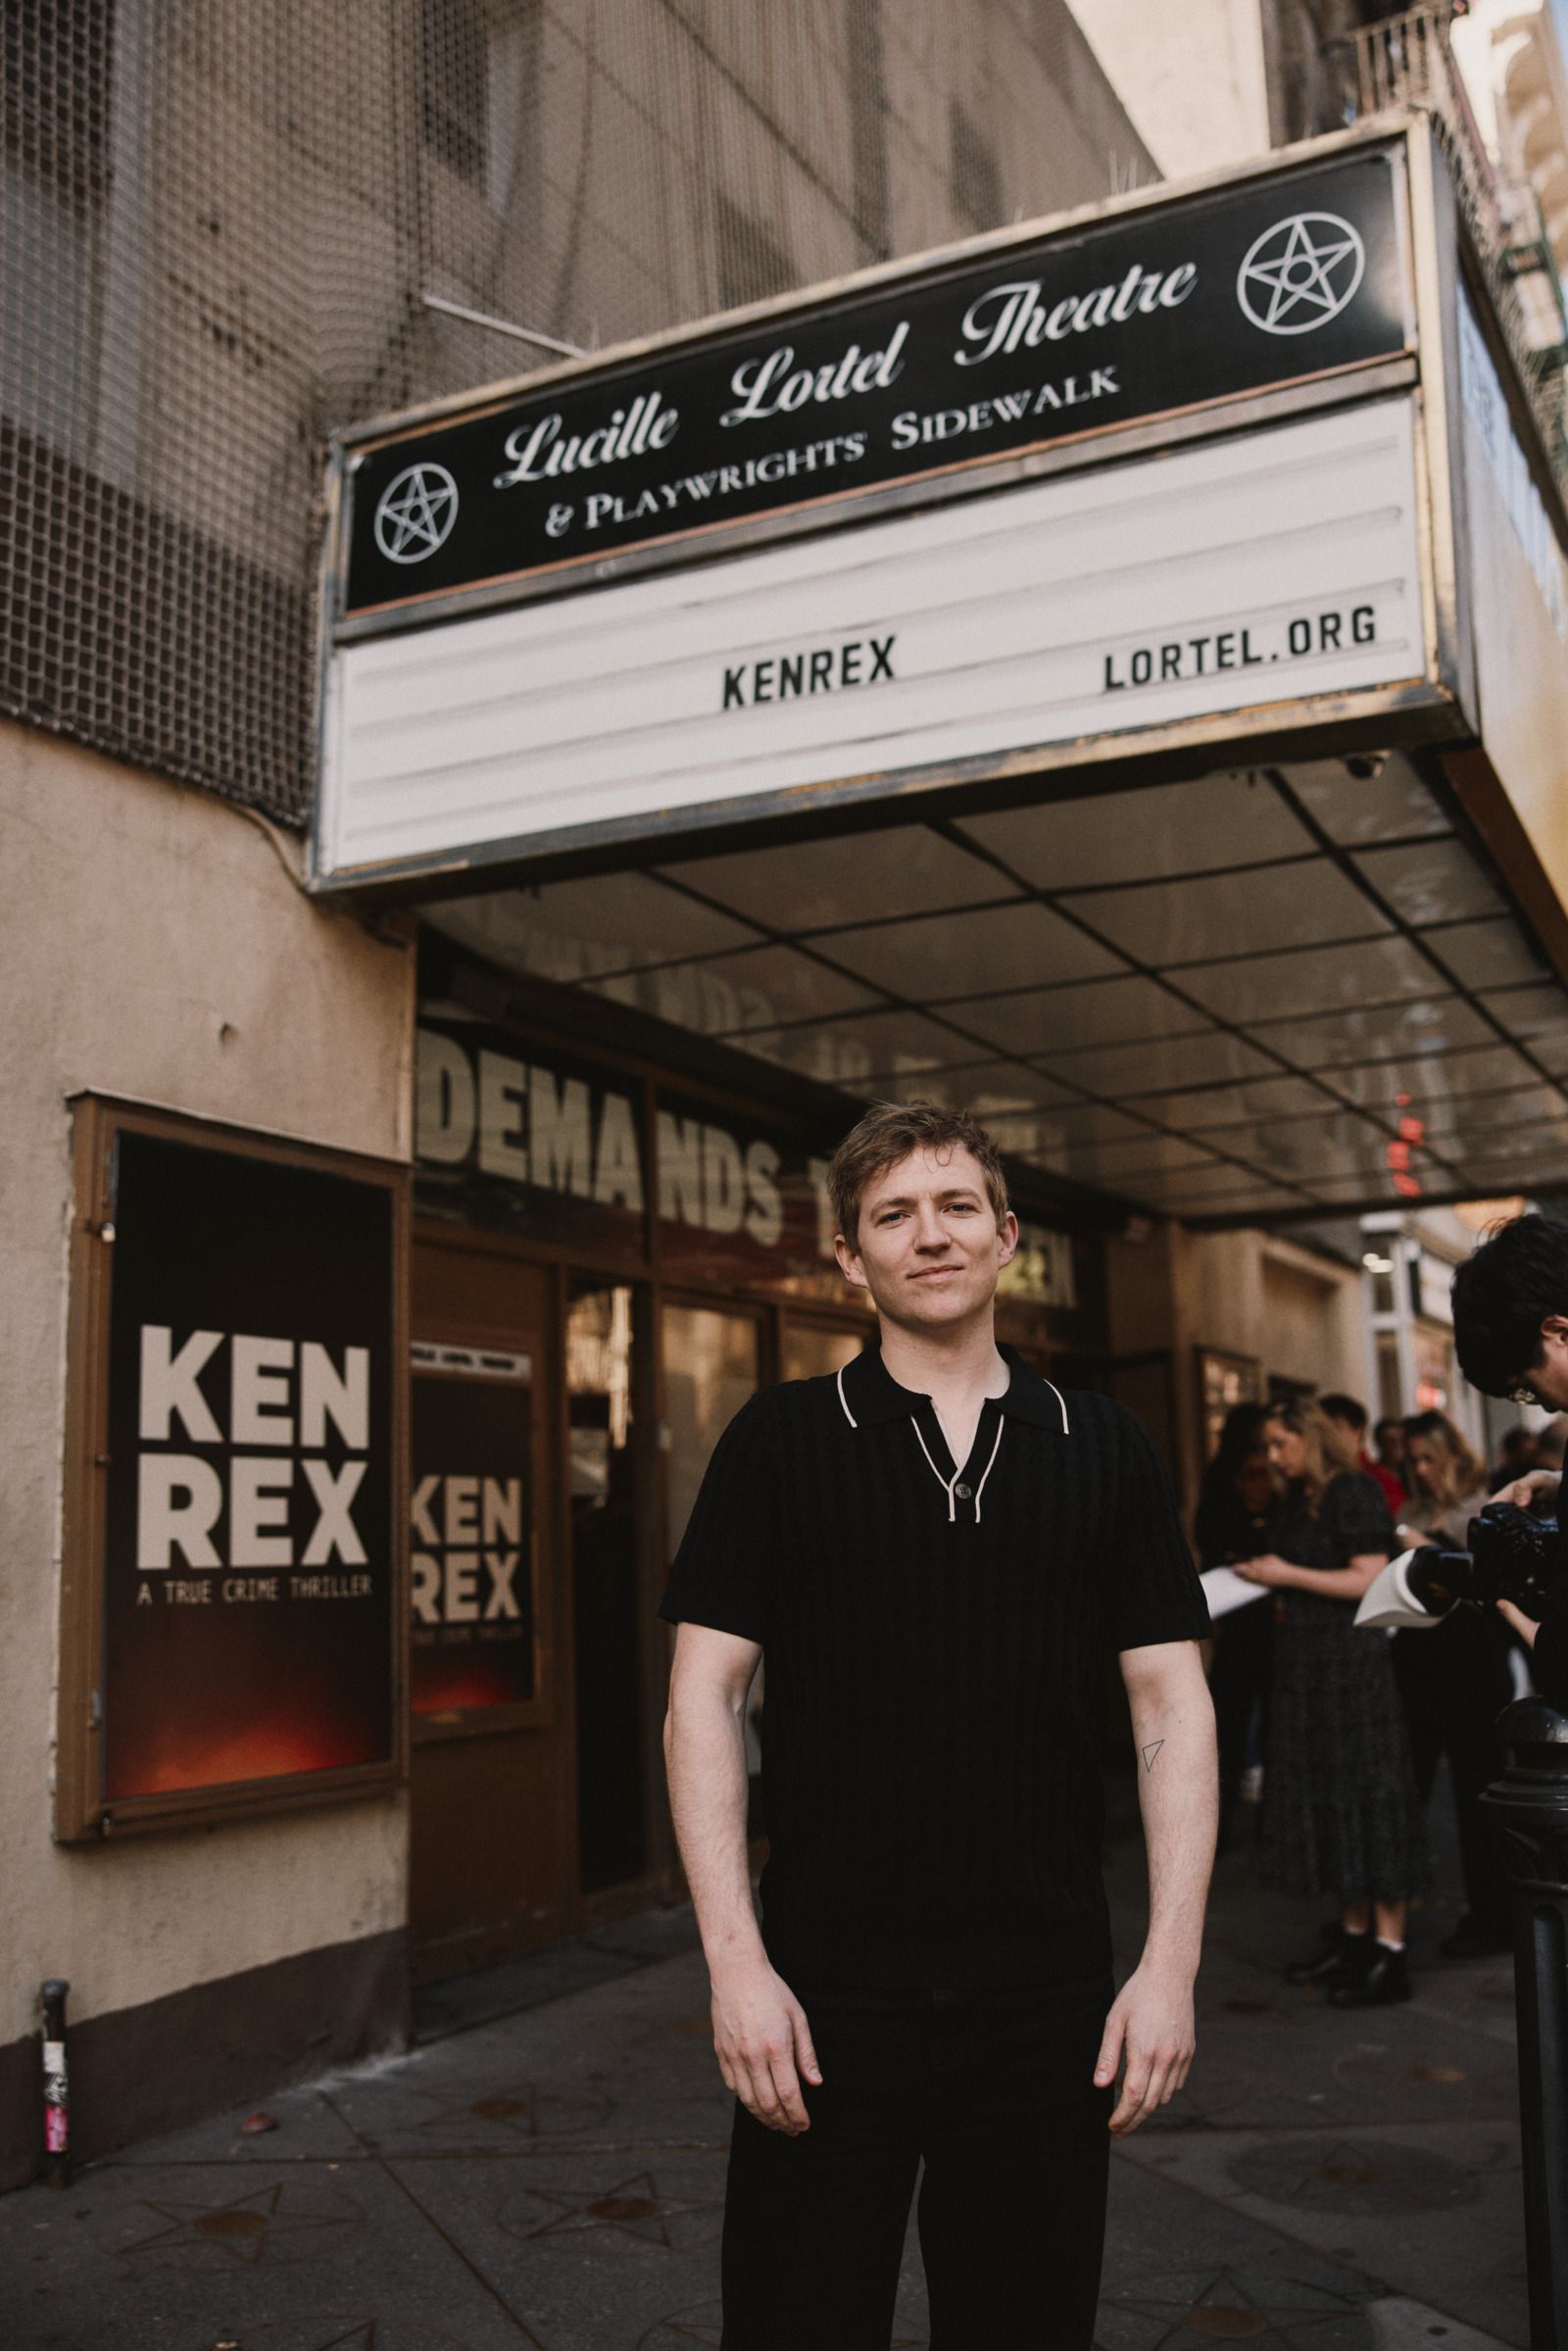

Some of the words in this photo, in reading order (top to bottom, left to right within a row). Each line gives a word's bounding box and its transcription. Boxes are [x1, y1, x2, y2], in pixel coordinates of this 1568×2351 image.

[492, 390, 679, 490] Lucille
[719, 321, 911, 428] Lortel
[954, 261, 1199, 367] Theatre
[544, 504, 573, 538] &
[890, 366, 1120, 451] SIDEWALK
[721, 635, 898, 712] KENREX
[1103, 605, 1377, 692] LORTEL.ORG
[416, 1027, 782, 1248] DEMANDS
[139, 1324, 369, 1450] KEN
[137, 1451, 368, 1570] REX
[412, 1474, 521, 1545] KEN
[136, 1582, 153, 1605] A
[164, 1579, 213, 1604] TRUE
[222, 1576, 280, 1602] CRIME
[290, 1573, 372, 1599] THRILLER
[412, 1550, 521, 1624] REX
